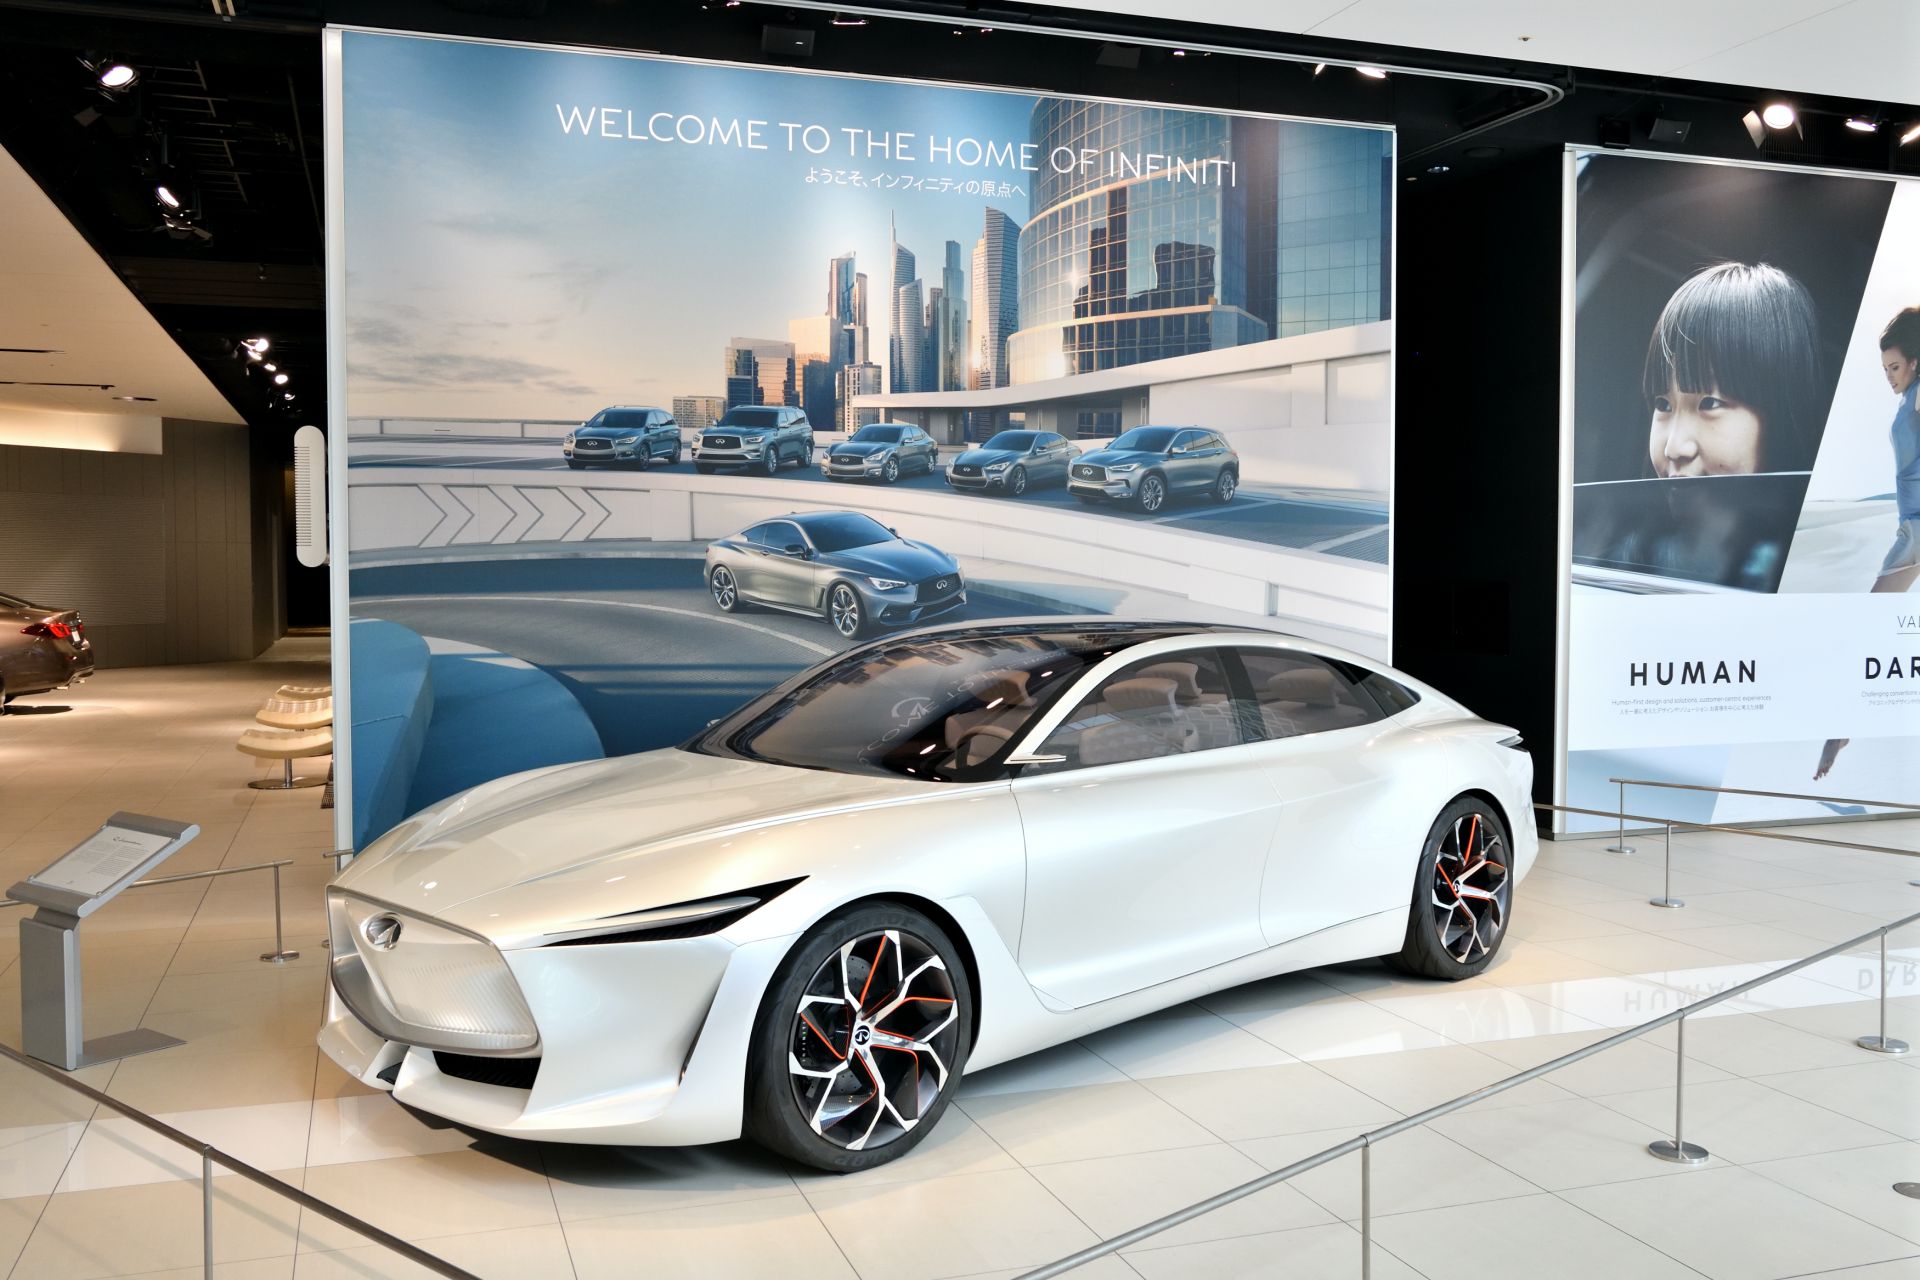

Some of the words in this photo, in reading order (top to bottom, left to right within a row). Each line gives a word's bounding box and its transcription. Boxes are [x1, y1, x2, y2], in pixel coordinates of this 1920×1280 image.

[555, 103, 768, 150] WELCOME
[779, 122, 830, 154] TO
[841, 127, 916, 161] THE
[929, 135, 1039, 172] HOME
[1051, 146, 1099, 175] OF
[1110, 150, 1237, 188] INFINITI
[805, 167, 1026, 198] ようこそ、インフィニティの原点へ
[1630, 660, 1756, 687] HUMAN
[1865, 656, 1920, 680] DAR
